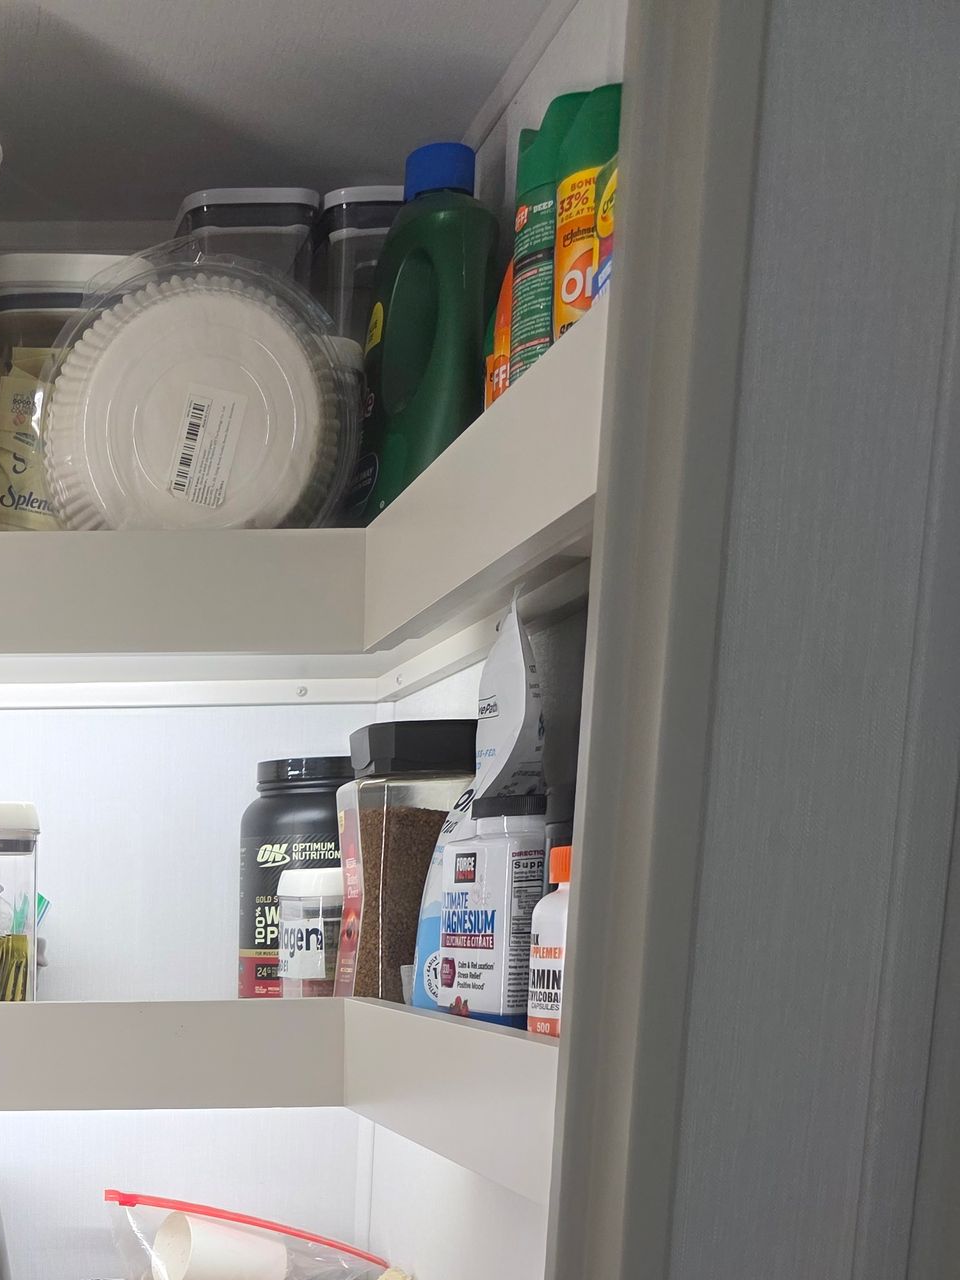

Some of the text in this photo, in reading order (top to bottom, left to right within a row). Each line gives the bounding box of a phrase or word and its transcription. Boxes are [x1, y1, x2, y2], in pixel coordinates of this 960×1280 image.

[533, 200, 553, 213] DEEP
[558, 189, 589, 217] 33%
[292, 842, 335, 852] OPTIMUM
[257, 843, 290, 867] ON
[292, 851, 341, 860] NUTRITION
[512, 850, 545, 858] DIRECTIO
[254, 906, 266, 945] 100%
[471, 935, 493, 948] CITRATE
[531, 1003, 560, 1011] CAPSULES
